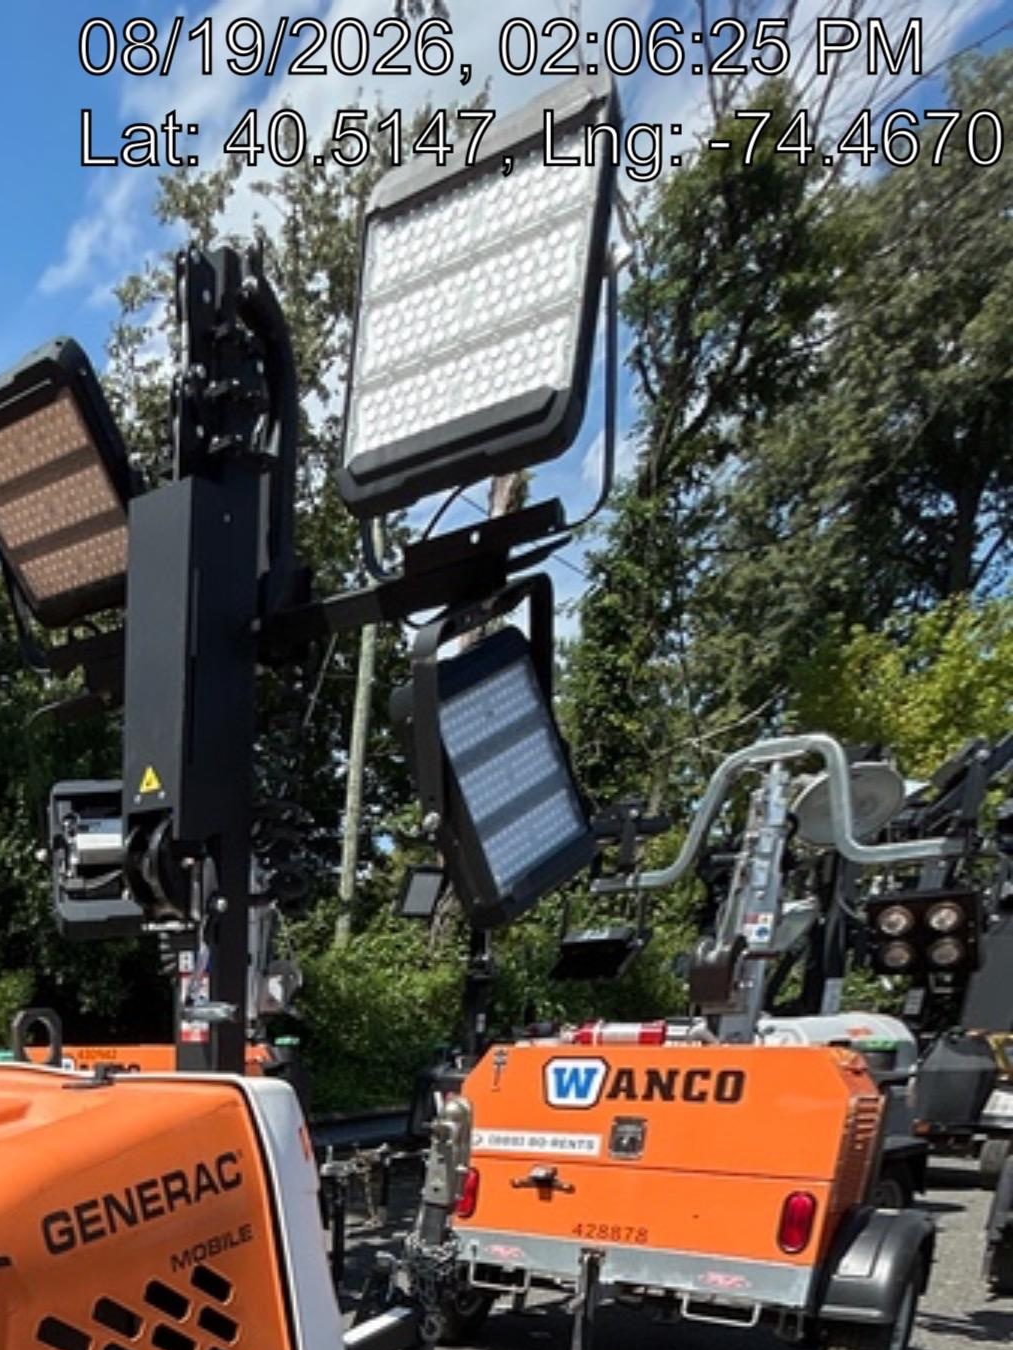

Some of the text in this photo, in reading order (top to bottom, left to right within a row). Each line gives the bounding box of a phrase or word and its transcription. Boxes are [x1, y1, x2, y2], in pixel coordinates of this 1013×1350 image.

[550, 1065, 746, 1105] WANCO
[41, 1152, 243, 1255] GENERAC
[170, 1223, 253, 1272] MOBILE
[571, 1222, 649, 1245] 428878
